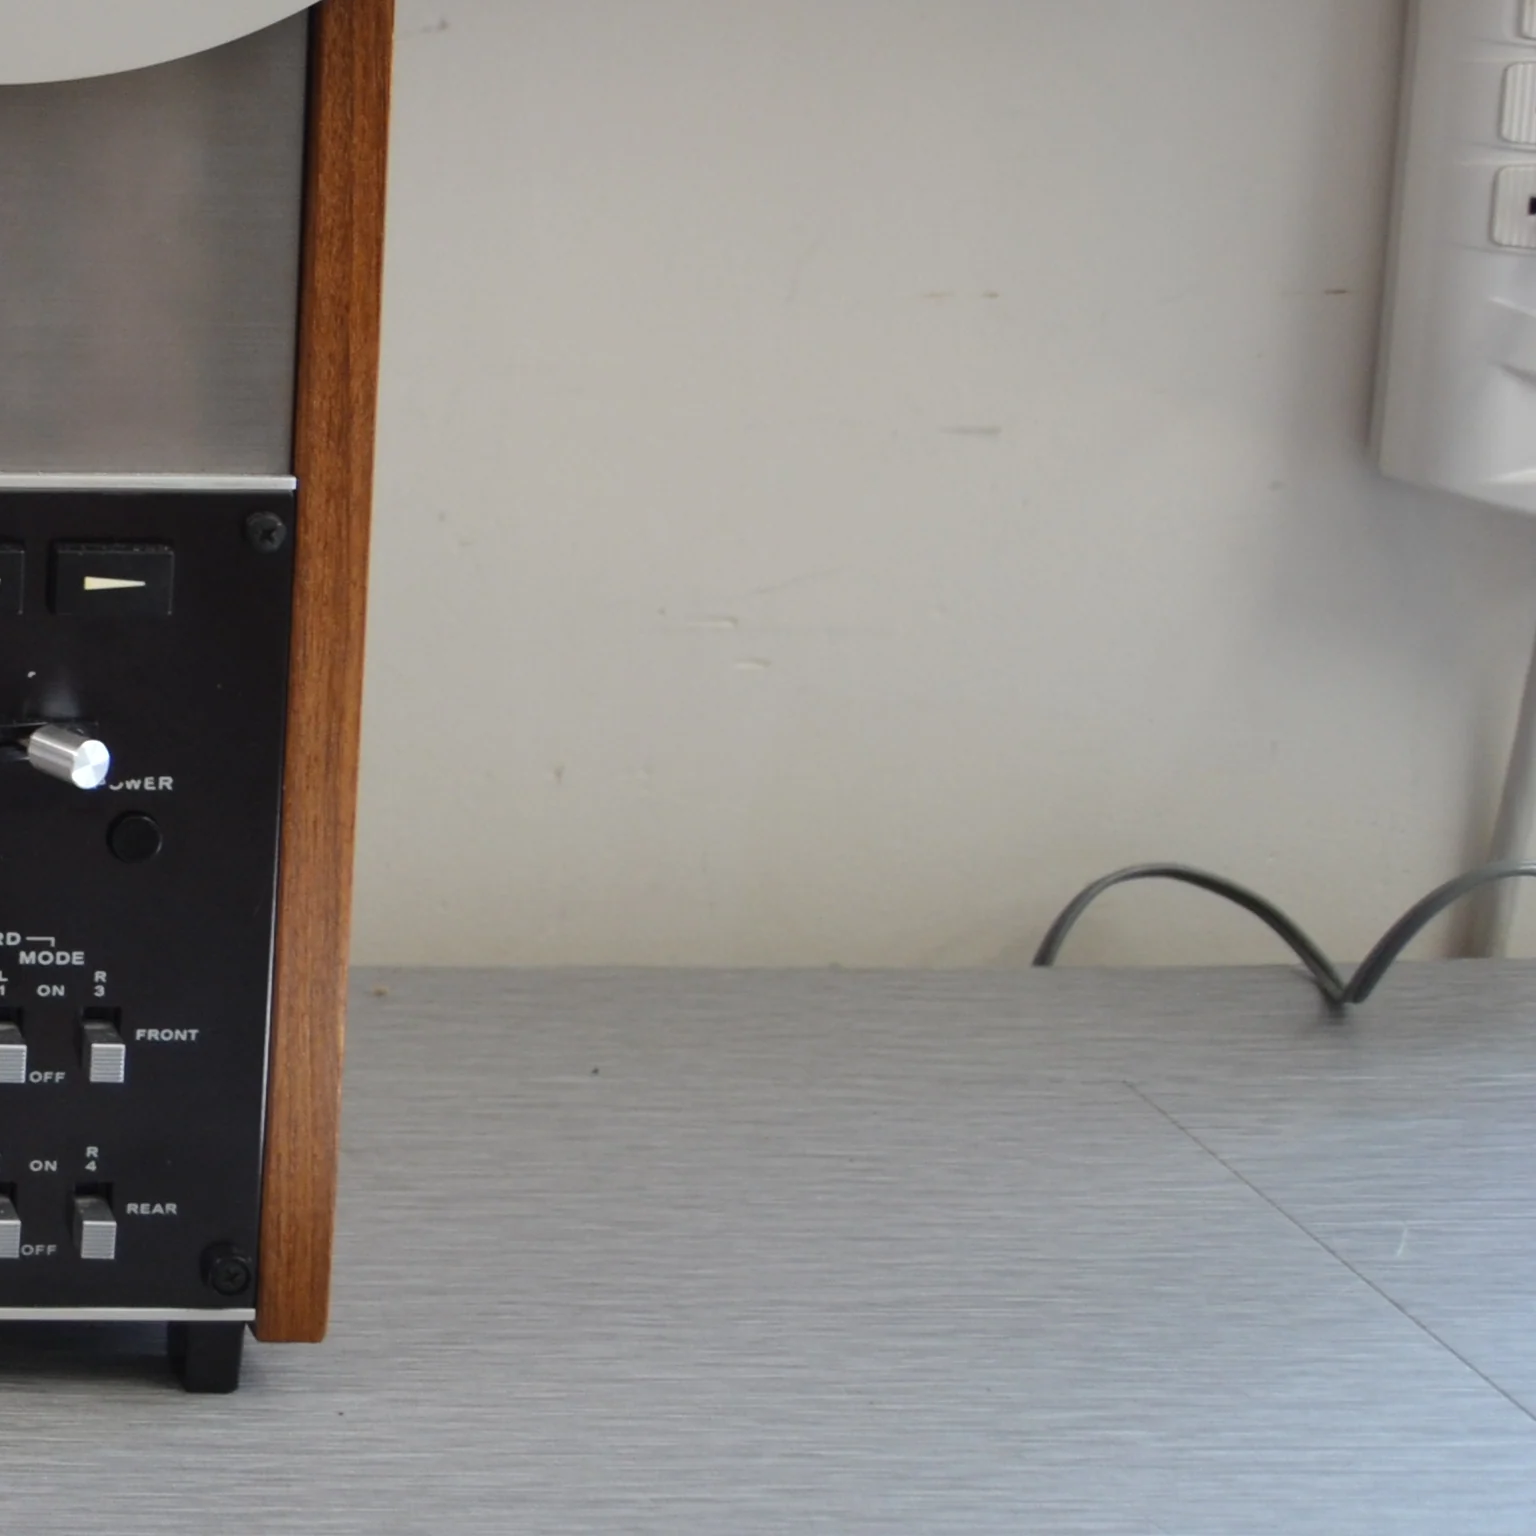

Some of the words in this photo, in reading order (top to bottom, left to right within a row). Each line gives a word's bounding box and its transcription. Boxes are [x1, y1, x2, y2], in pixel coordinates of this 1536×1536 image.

[19, 951, 85, 965] MODE
[37, 985, 65, 997] ON
[136, 1029, 199, 1041] FRONT
[29, 1072, 65, 1083] OFF
[30, 1160, 57, 1172] ON
[127, 1203, 178, 1215] REAR
[21, 1245, 57, 1256] OFF
